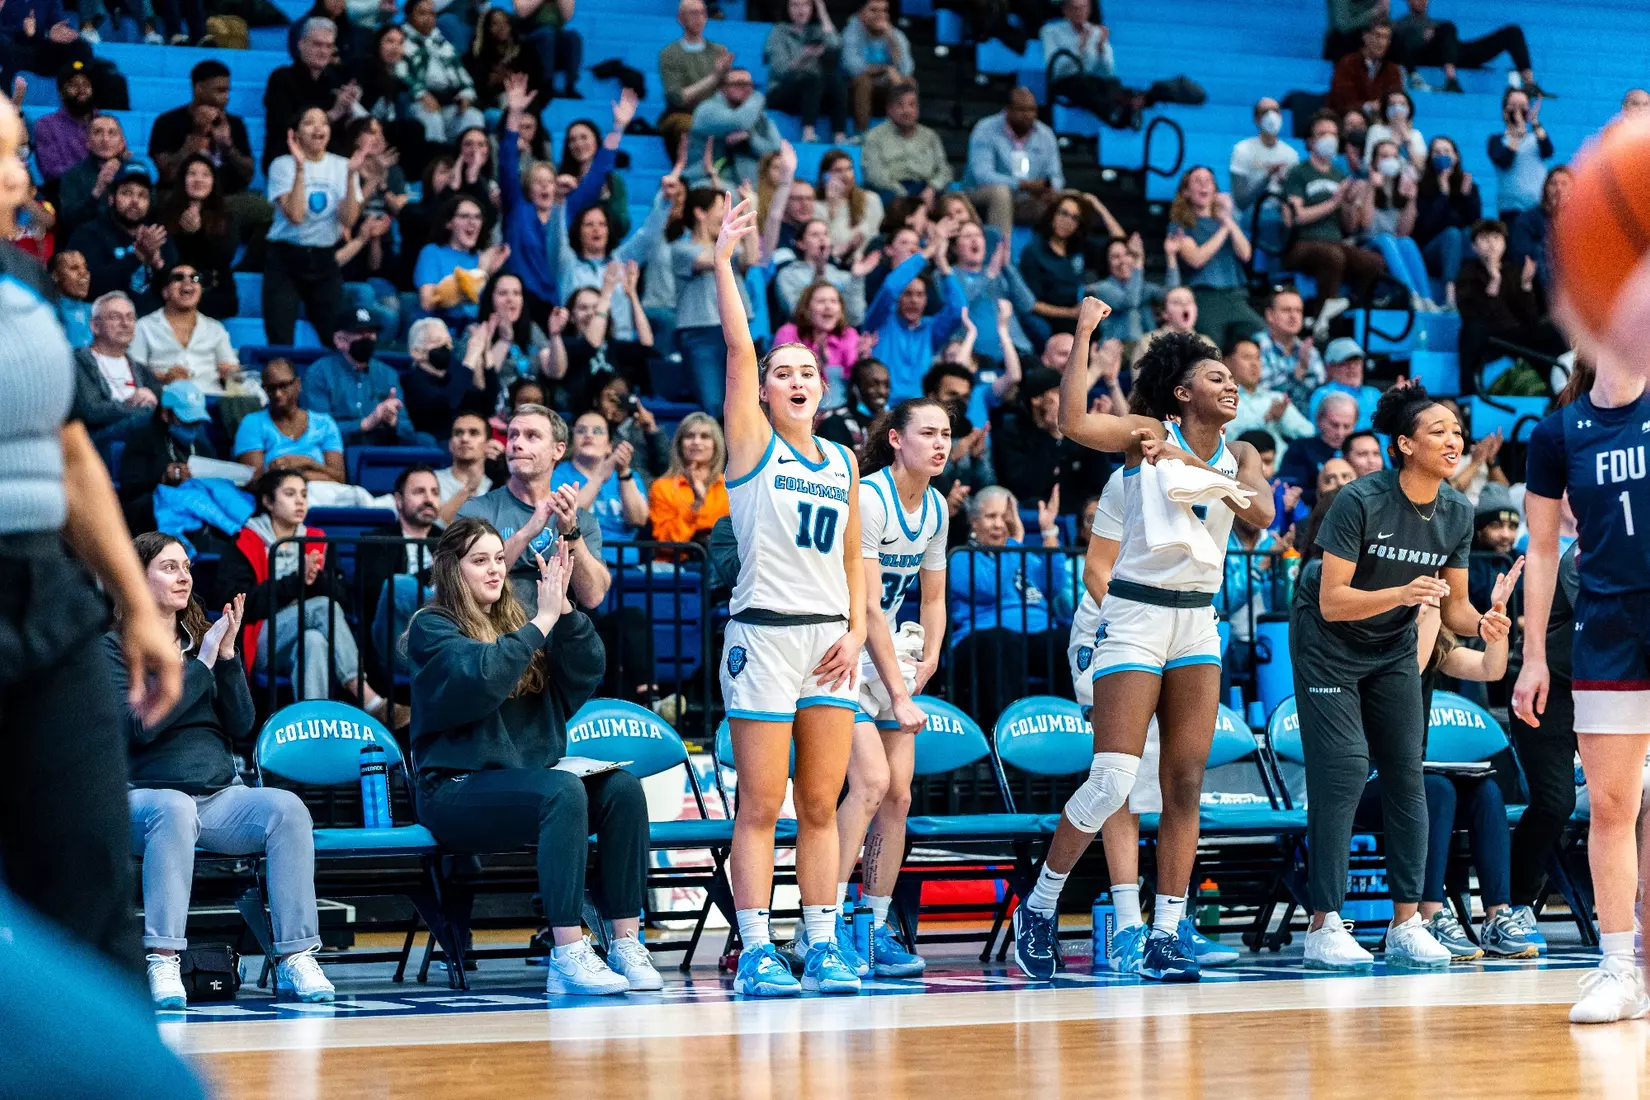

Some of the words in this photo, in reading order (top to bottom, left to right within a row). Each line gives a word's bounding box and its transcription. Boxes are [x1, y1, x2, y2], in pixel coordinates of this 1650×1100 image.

[1596, 446, 1646, 485] FDU
[774, 475, 849, 505] COLUMBI
[1619, 491, 1635, 536] 1
[796, 500, 838, 554] 10
[1367, 544, 1448, 566] COLUMBIA
[275, 719, 375, 744] COLUMBIA
[569, 719, 662, 743] COLUMBIA
[1010, 714, 1094, 737] COLUMBIA
[361, 765, 384, 773] OWERADE
